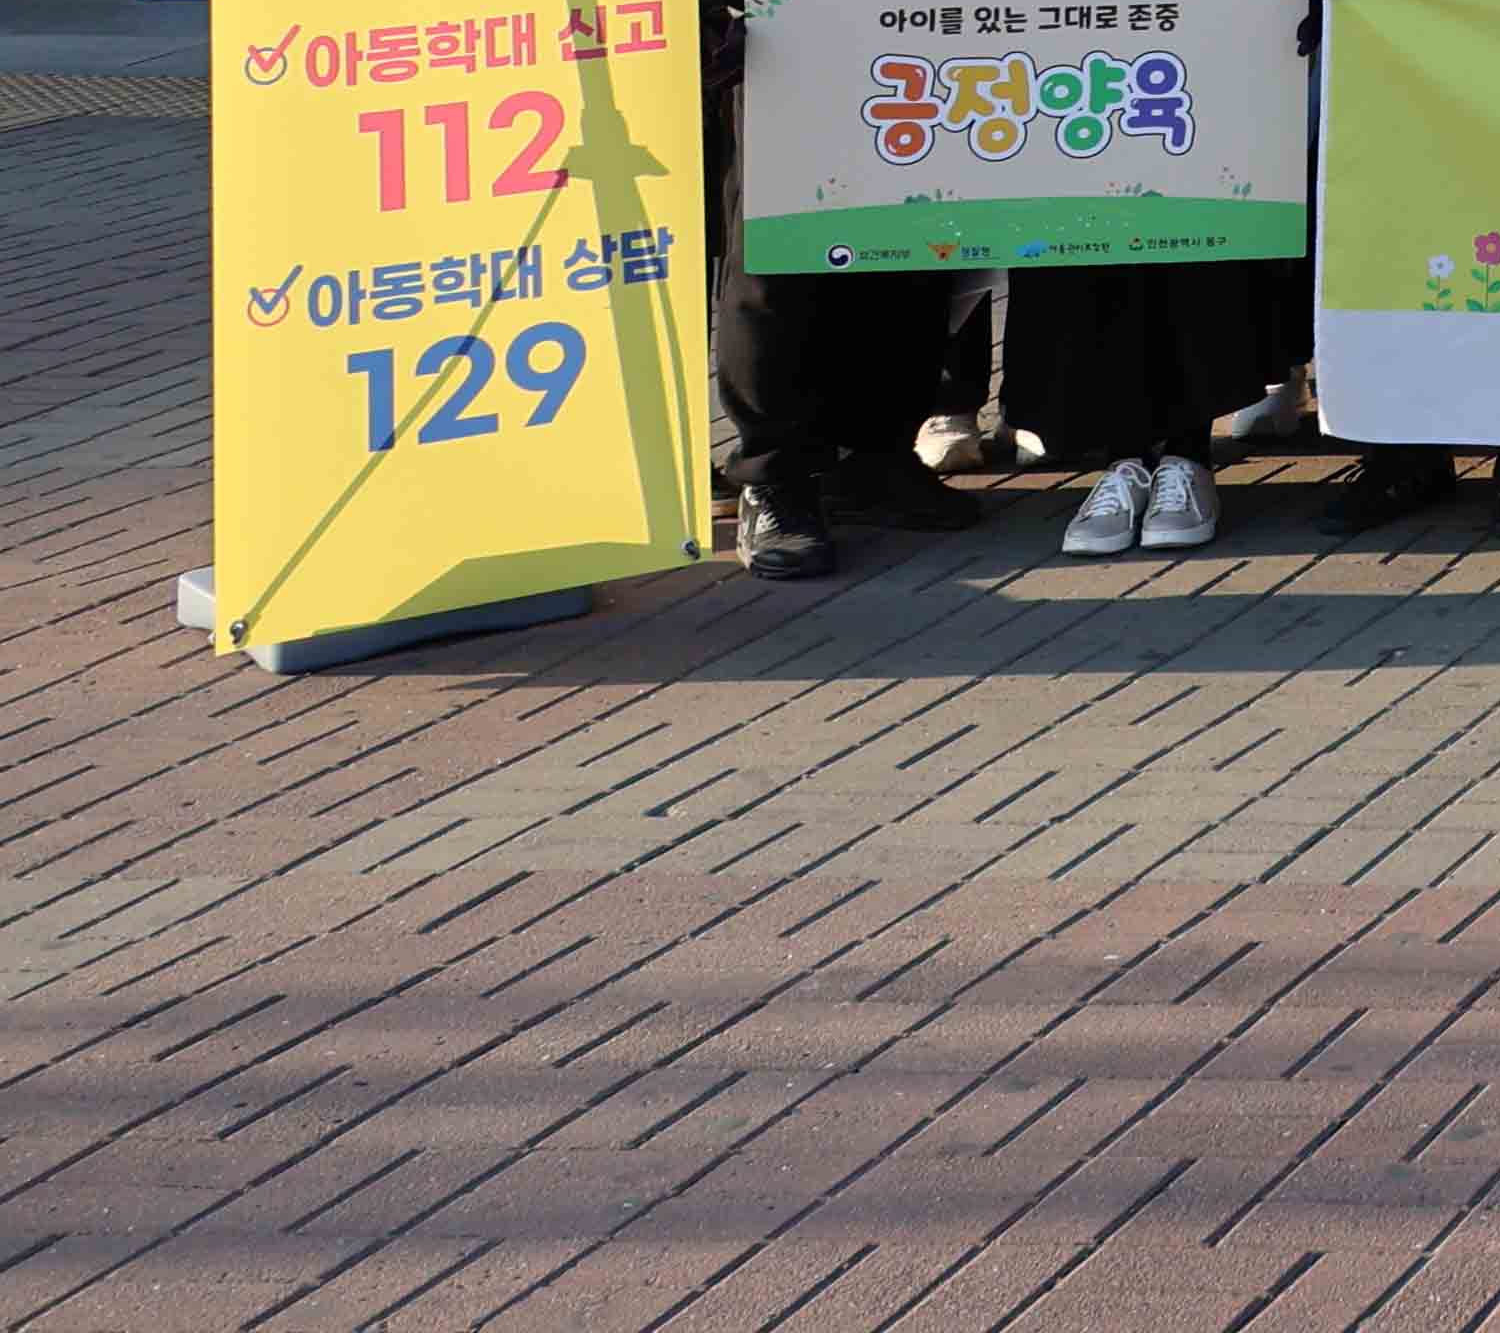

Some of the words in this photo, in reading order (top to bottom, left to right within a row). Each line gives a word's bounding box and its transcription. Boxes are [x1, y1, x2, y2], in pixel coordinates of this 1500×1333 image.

[303, 8, 537, 89] 아동학대
[879, 6, 964, 36] 아이를
[974, 5, 1028, 34] 있는
[1037, 4, 1119, 30] 그대로
[1127, 2, 1180, 32] 존중
[360, 91, 570, 215] 112
[870, 57, 1188, 157] 긍정양육
[305, 246, 542, 331] 아동학대
[562, 227, 675, 297] 상담
[346, 319, 587, 455] 129
